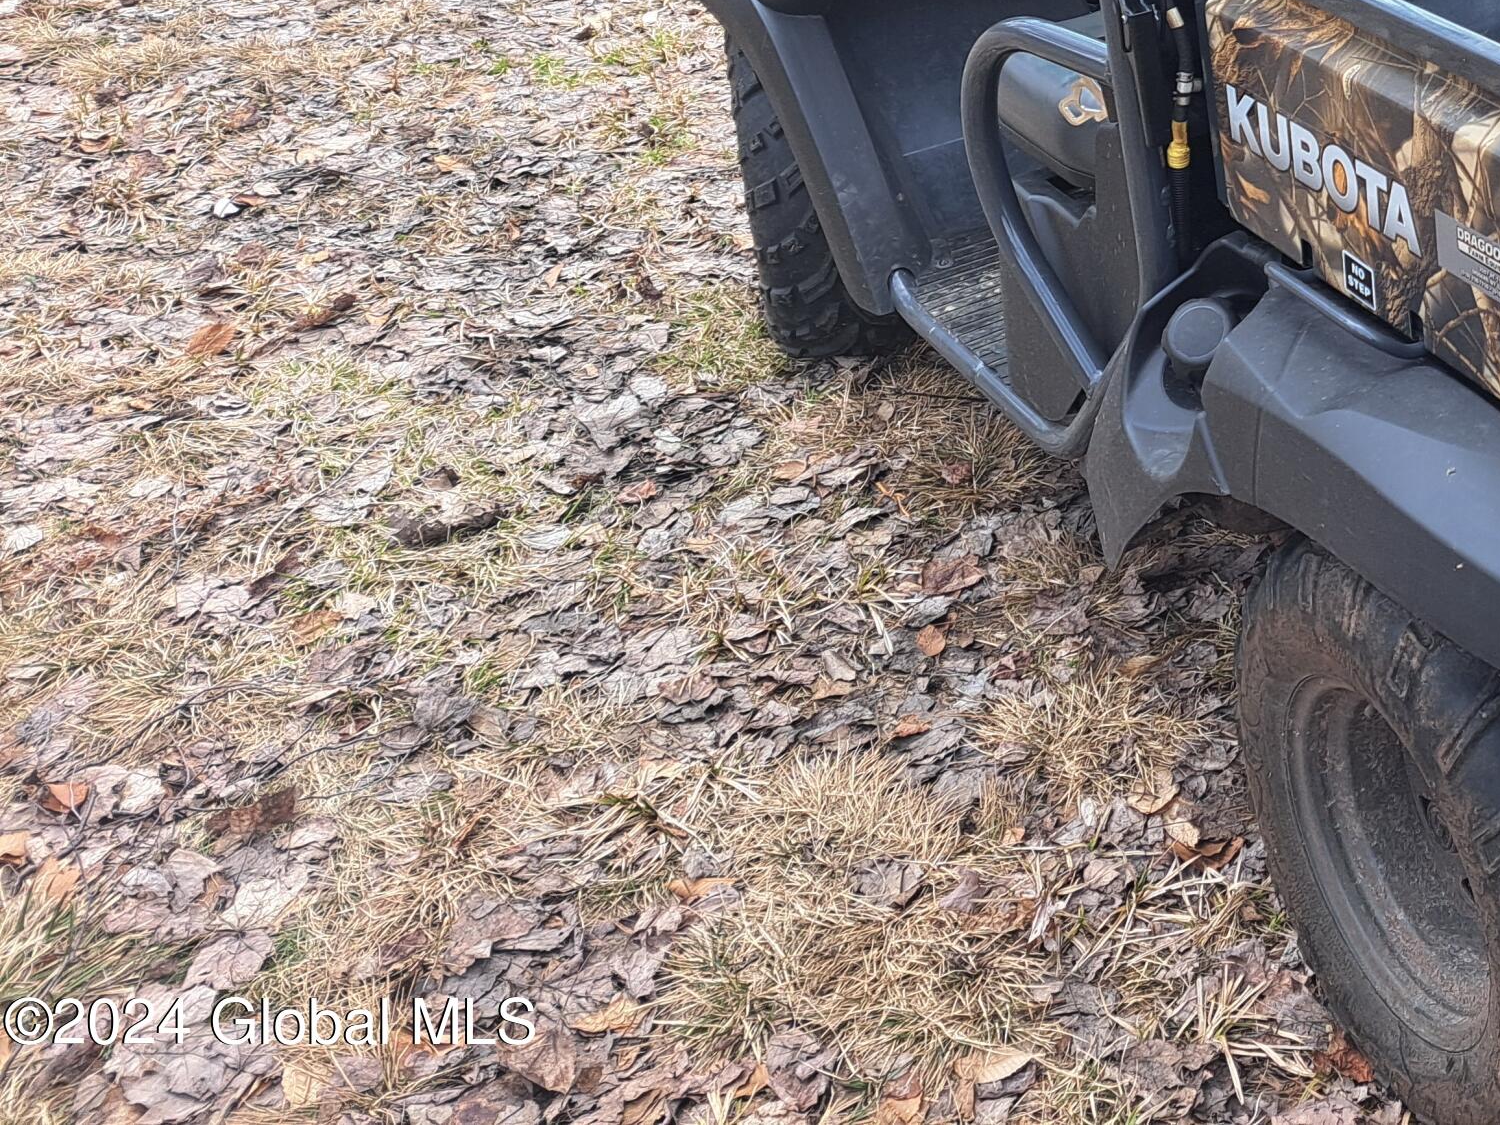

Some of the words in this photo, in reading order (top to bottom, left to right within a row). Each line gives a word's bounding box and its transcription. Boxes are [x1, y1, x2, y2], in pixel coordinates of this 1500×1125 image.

[1226, 83, 1423, 258] KUBOTA
[1351, 262, 1365, 280] NO
[1347, 274, 1371, 297] STEP
